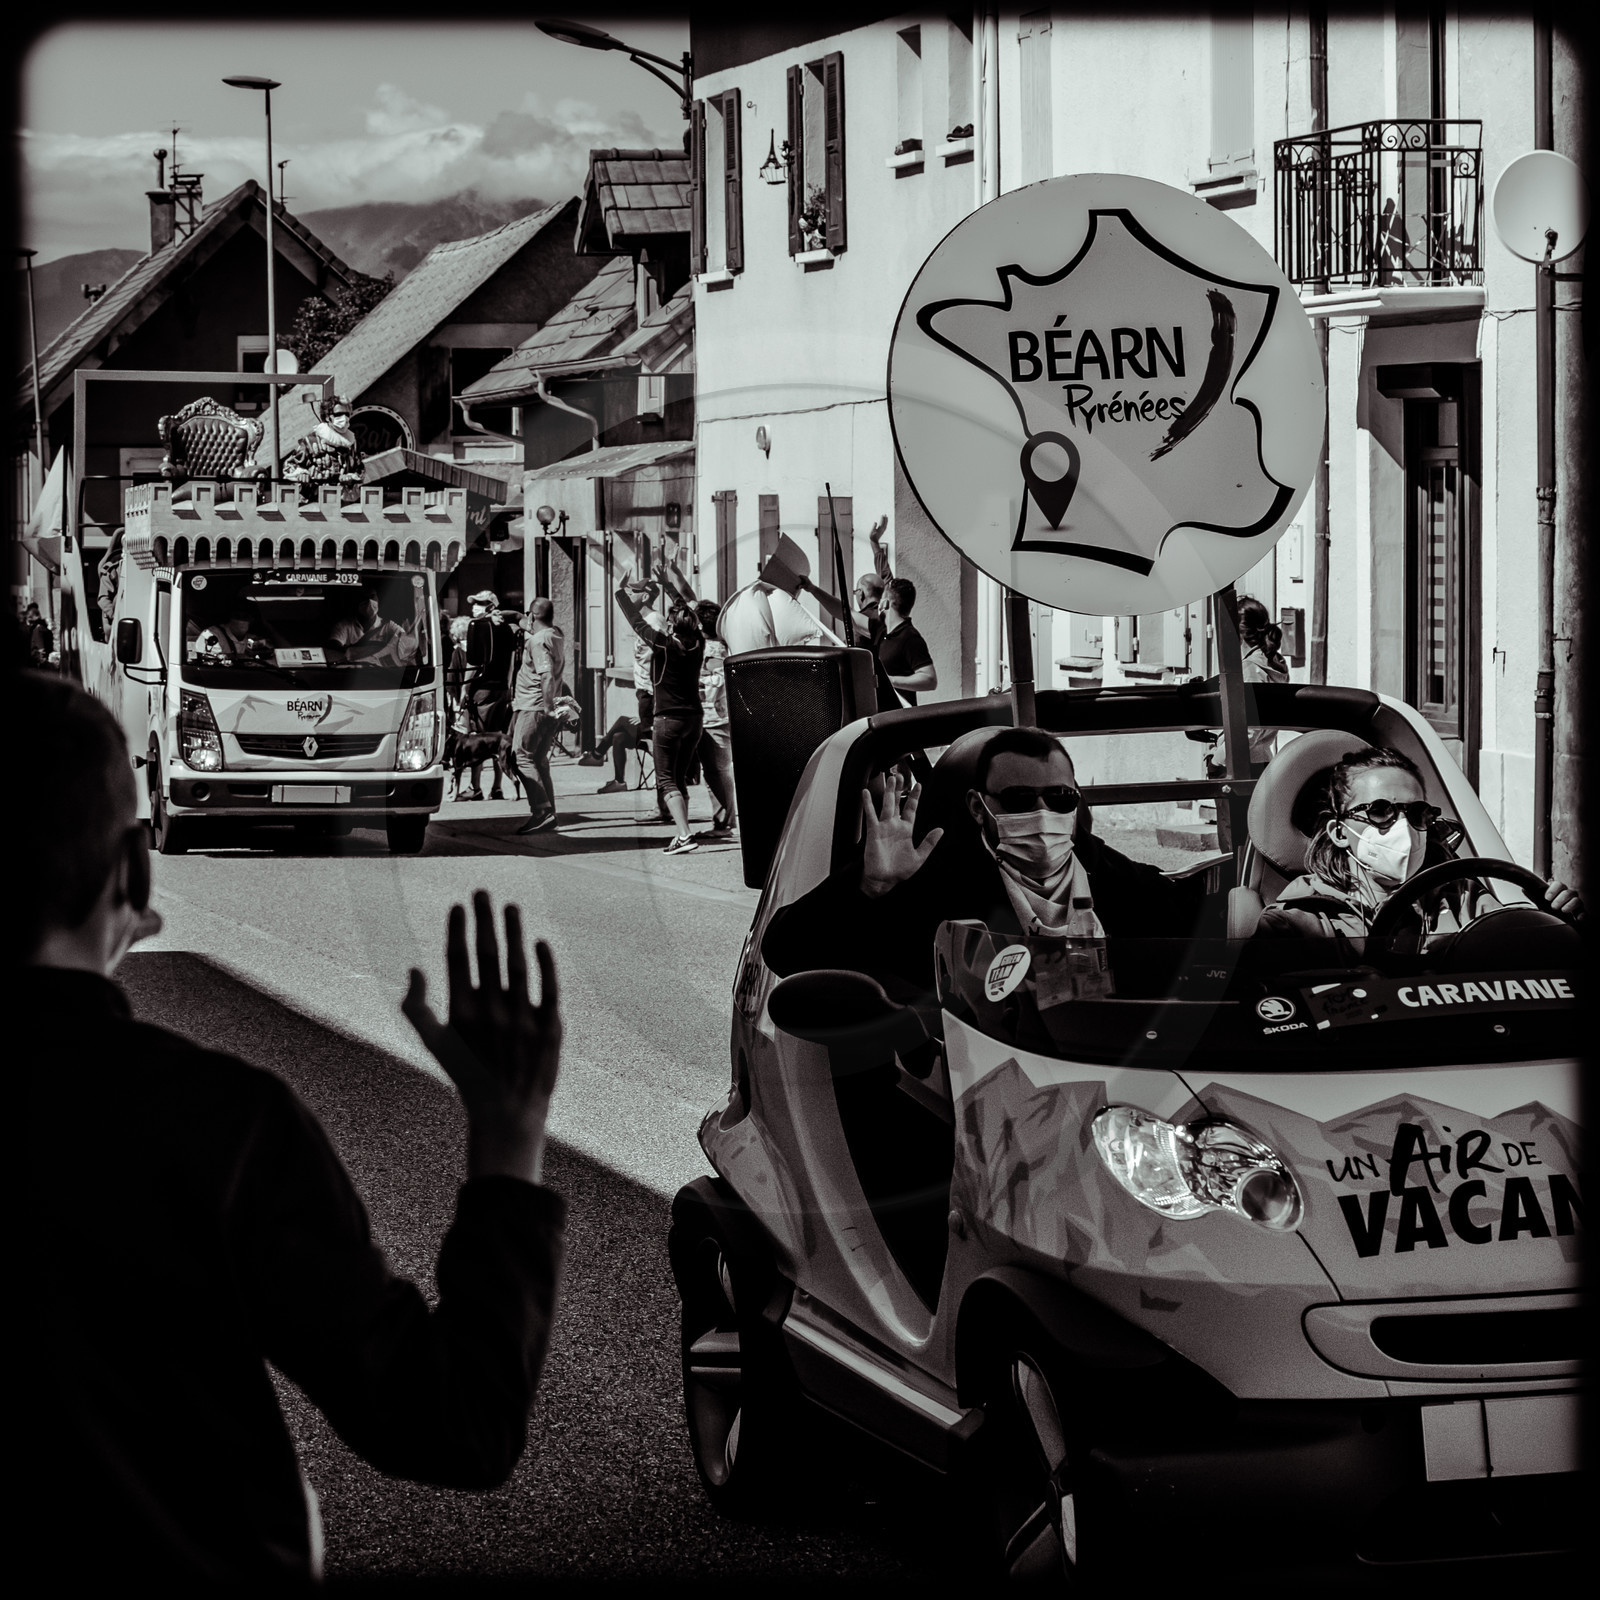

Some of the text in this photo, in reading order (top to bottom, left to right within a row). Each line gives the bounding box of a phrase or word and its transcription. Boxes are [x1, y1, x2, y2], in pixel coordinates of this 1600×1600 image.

[1006, 314, 1186, 383] BÉARN
[1062, 383, 1187, 434] Pyrénées
[286, 573, 359, 584] CARAVANE 2039
[287, 698, 323, 711] BÉARN
[1206, 969, 1227, 979] JVC
[1397, 978, 1575, 1007] CARAVANE
[1326, 1153, 1380, 1182] UN
[1502, 1141, 1542, 1166] DE
